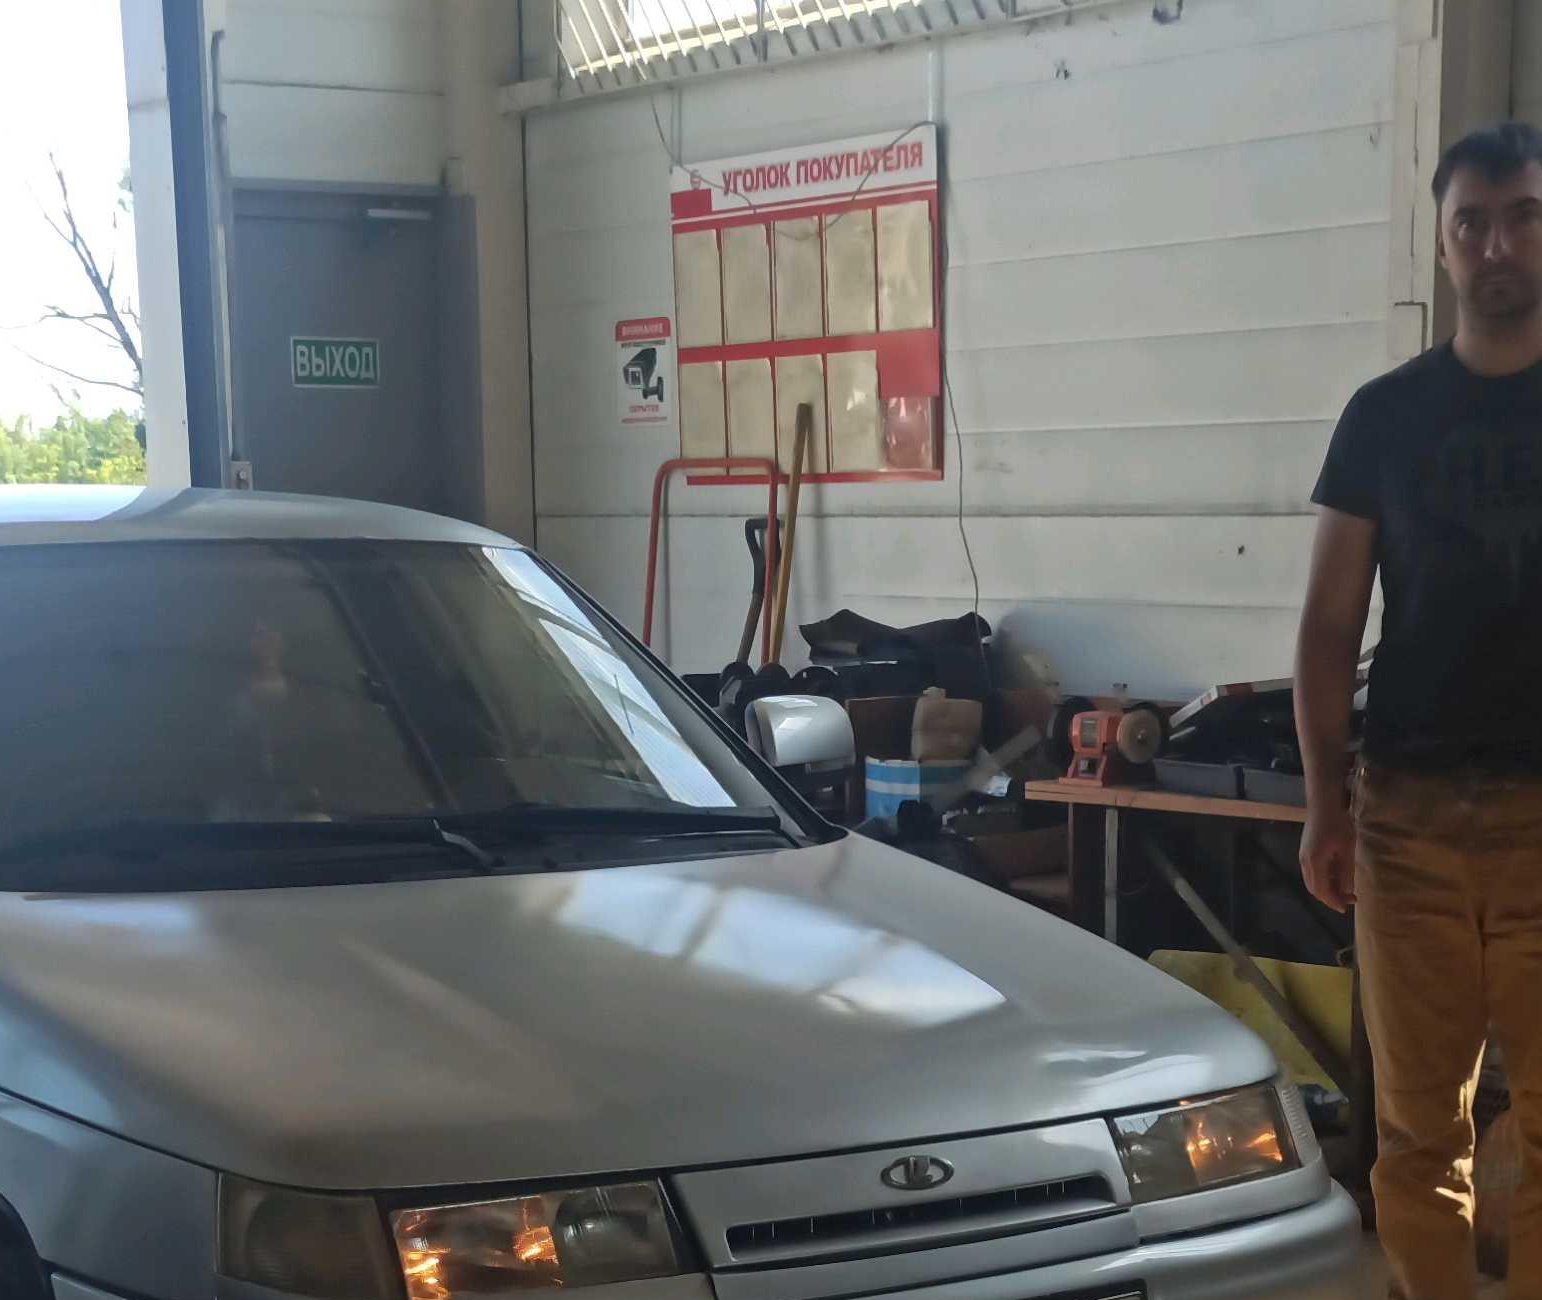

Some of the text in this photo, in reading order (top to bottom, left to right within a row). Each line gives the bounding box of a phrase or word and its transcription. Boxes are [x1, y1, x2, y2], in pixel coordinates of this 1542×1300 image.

[722, 141, 923, 195] УГОЛОК ПОКУПАТЕЛЯ
[295, 344, 375, 380] ВЫХОД
